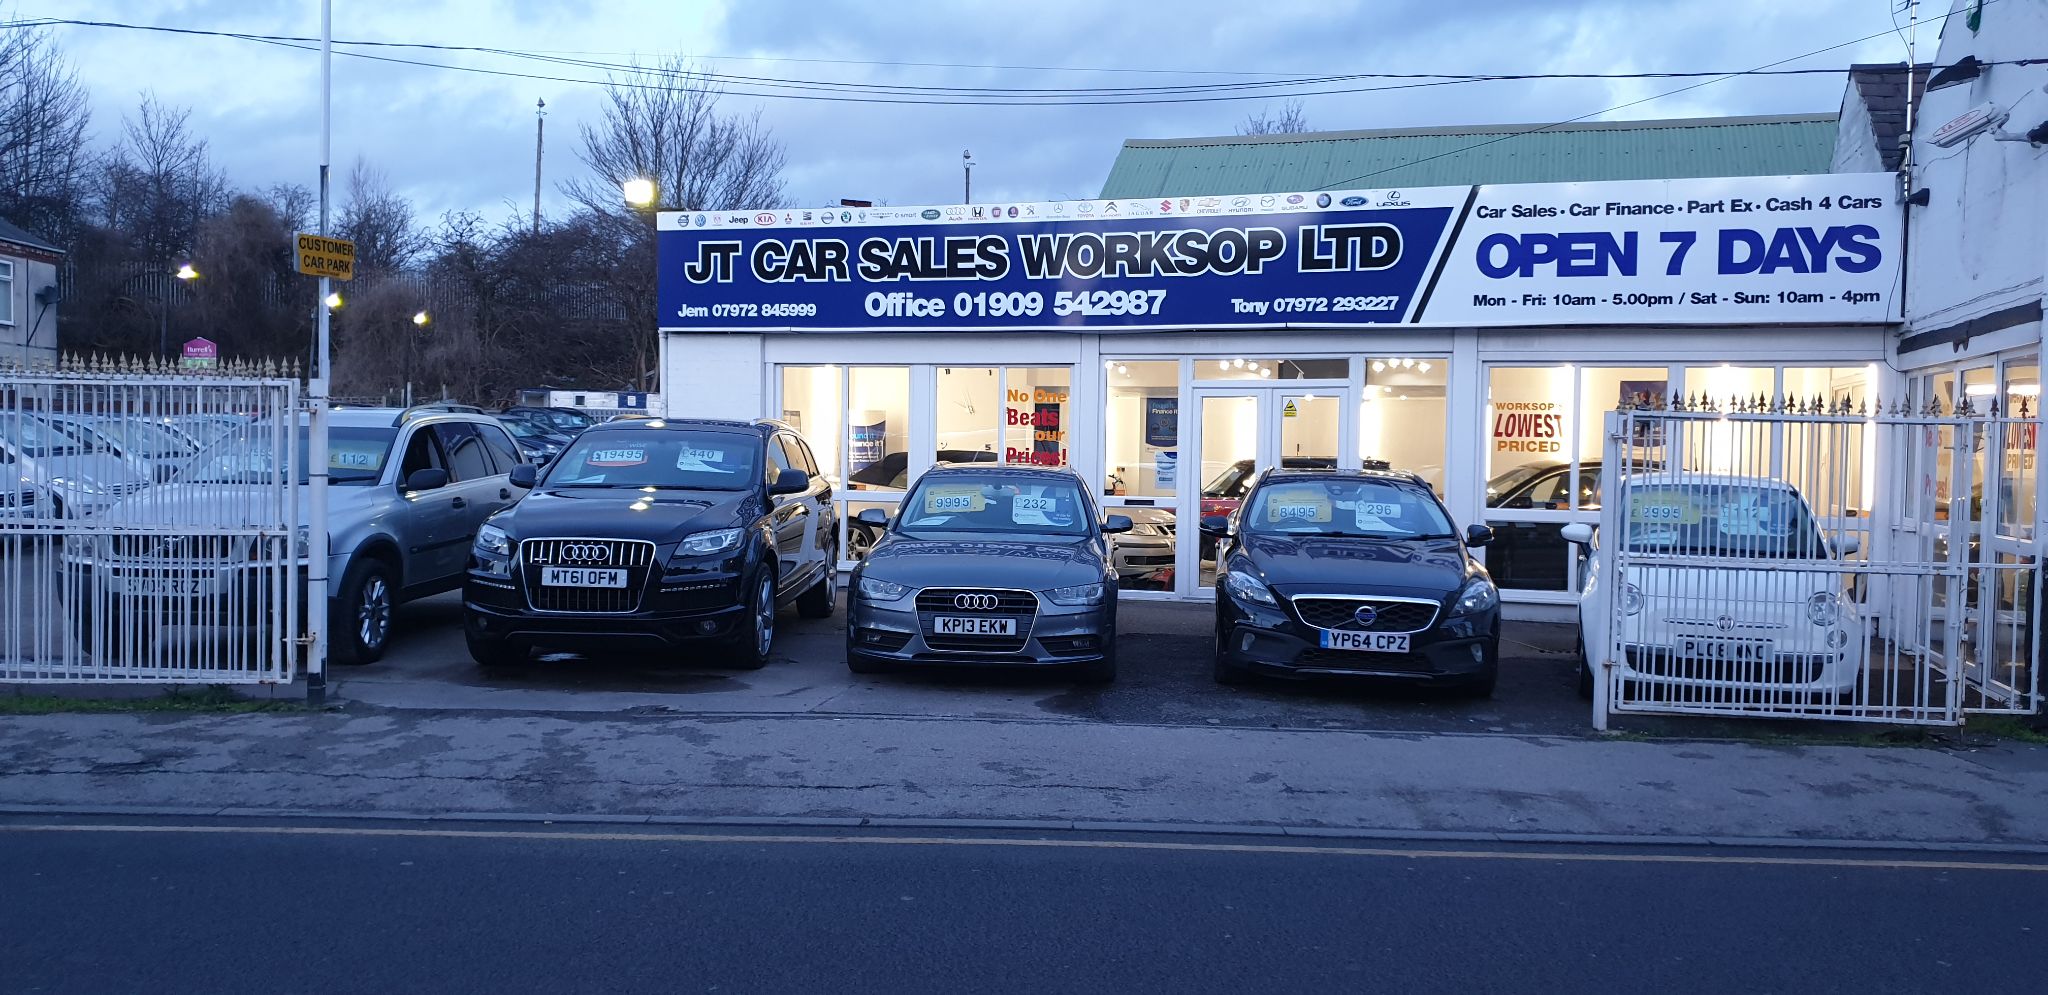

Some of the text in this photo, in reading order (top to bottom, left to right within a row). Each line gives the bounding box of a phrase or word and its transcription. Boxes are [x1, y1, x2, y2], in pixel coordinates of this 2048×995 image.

[1476, 195, 1883, 220] Car Sales Car Finance Part Ex Cash 4 Cars
[729, 216, 749, 224] Jeep
[299, 237, 354, 256] CUSTOMER
[684, 222, 1404, 283] JT CAR SALES WORKSOP LTD
[1476, 225, 1883, 279] OPEN 7 DAYS
[303, 255, 350, 273] CAR PARK
[864, 289, 1167, 318] Office 01909 542987
[1231, 295, 1400, 316] Tony 07972 293227
[1473, 294, 1508, 307] Mon
[1522, 294, 1547, 306] Fri:
[1552, 293, 1596, 306] 10am
[1612, 292, 1674, 308] 5.00pm
[1690, 291, 1718, 305] Sat
[1734, 291, 1770, 305] Sun:
[1777, 291, 1824, 304] 10am
[1841, 290, 1881, 306] 4pm
[677, 303, 818, 319] Jem 07972 845999
[1007, 389, 1067, 402] No One
[1007, 408, 1059, 426] Beats
[1494, 413, 1562, 438] LOWEST
[1034, 430, 1066, 442] our
[1497, 440, 1561, 453] PRICED
[1006, 447, 1067, 465] Prices!
[551, 570, 618, 585] MT61 OFM
[942, 618, 1008, 634] KP13 EKW
[1331, 632, 1407, 651] YP64 CPZ
